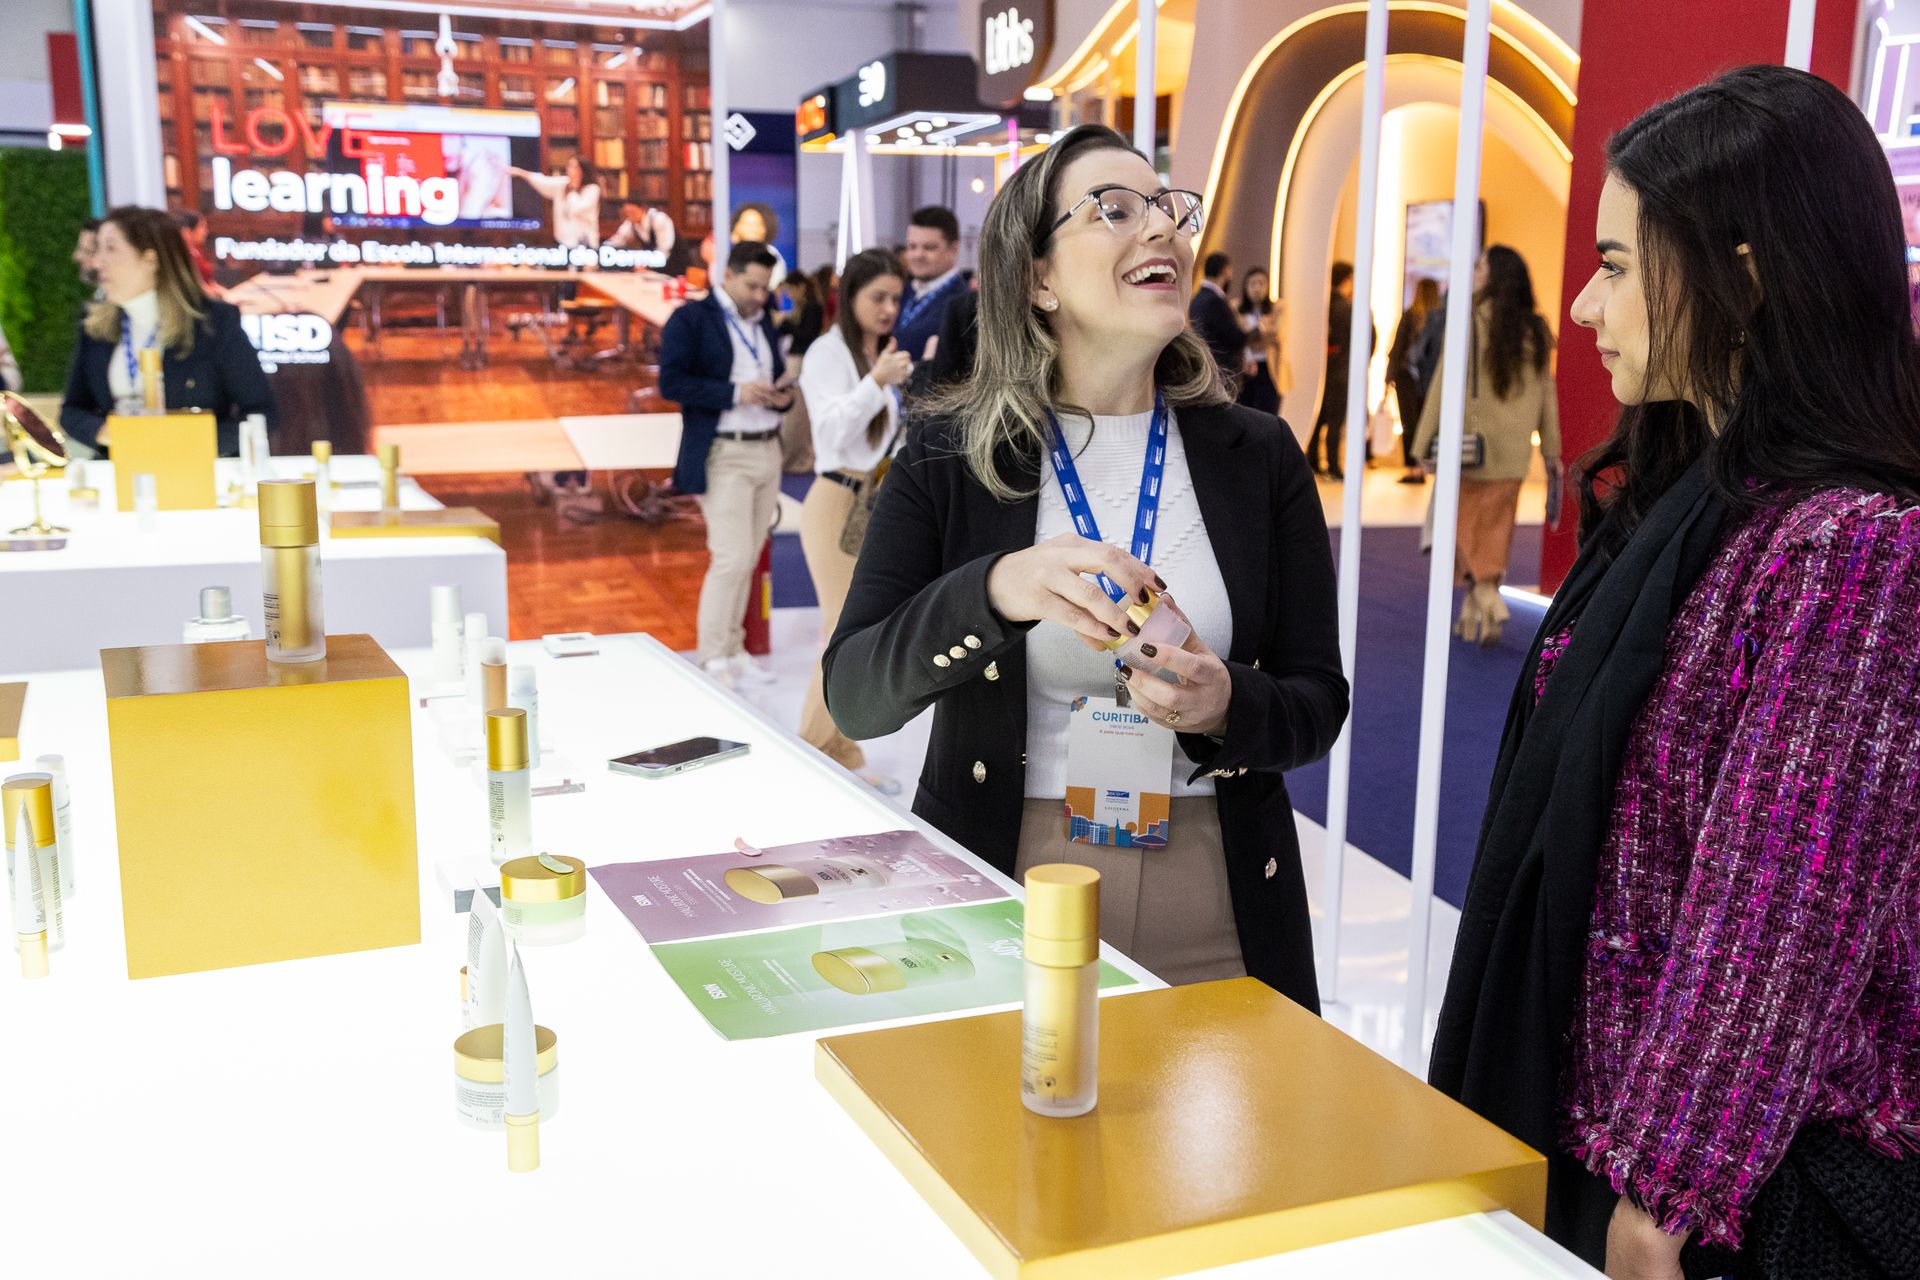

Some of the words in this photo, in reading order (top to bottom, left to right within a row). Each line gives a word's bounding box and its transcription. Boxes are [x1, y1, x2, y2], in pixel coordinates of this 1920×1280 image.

[210, 104, 373, 158] LOVE
[212, 156, 460, 226] learning
[215, 237, 328, 261] Fundador
[328, 239, 361, 263] da
[361, 240, 434, 263] Escola
[434, 242, 568, 266] Internacional
[568, 244, 599, 266] de
[599, 245, 667, 268] Derma
[1092, 711, 1149, 724] CURITIBA
[718, 959, 750, 984] MOISTURE
[899, 957, 918, 969] ISDIN
[703, 983, 728, 999] ISDIN
[740, 982, 780, 1015] HYALURONIC
